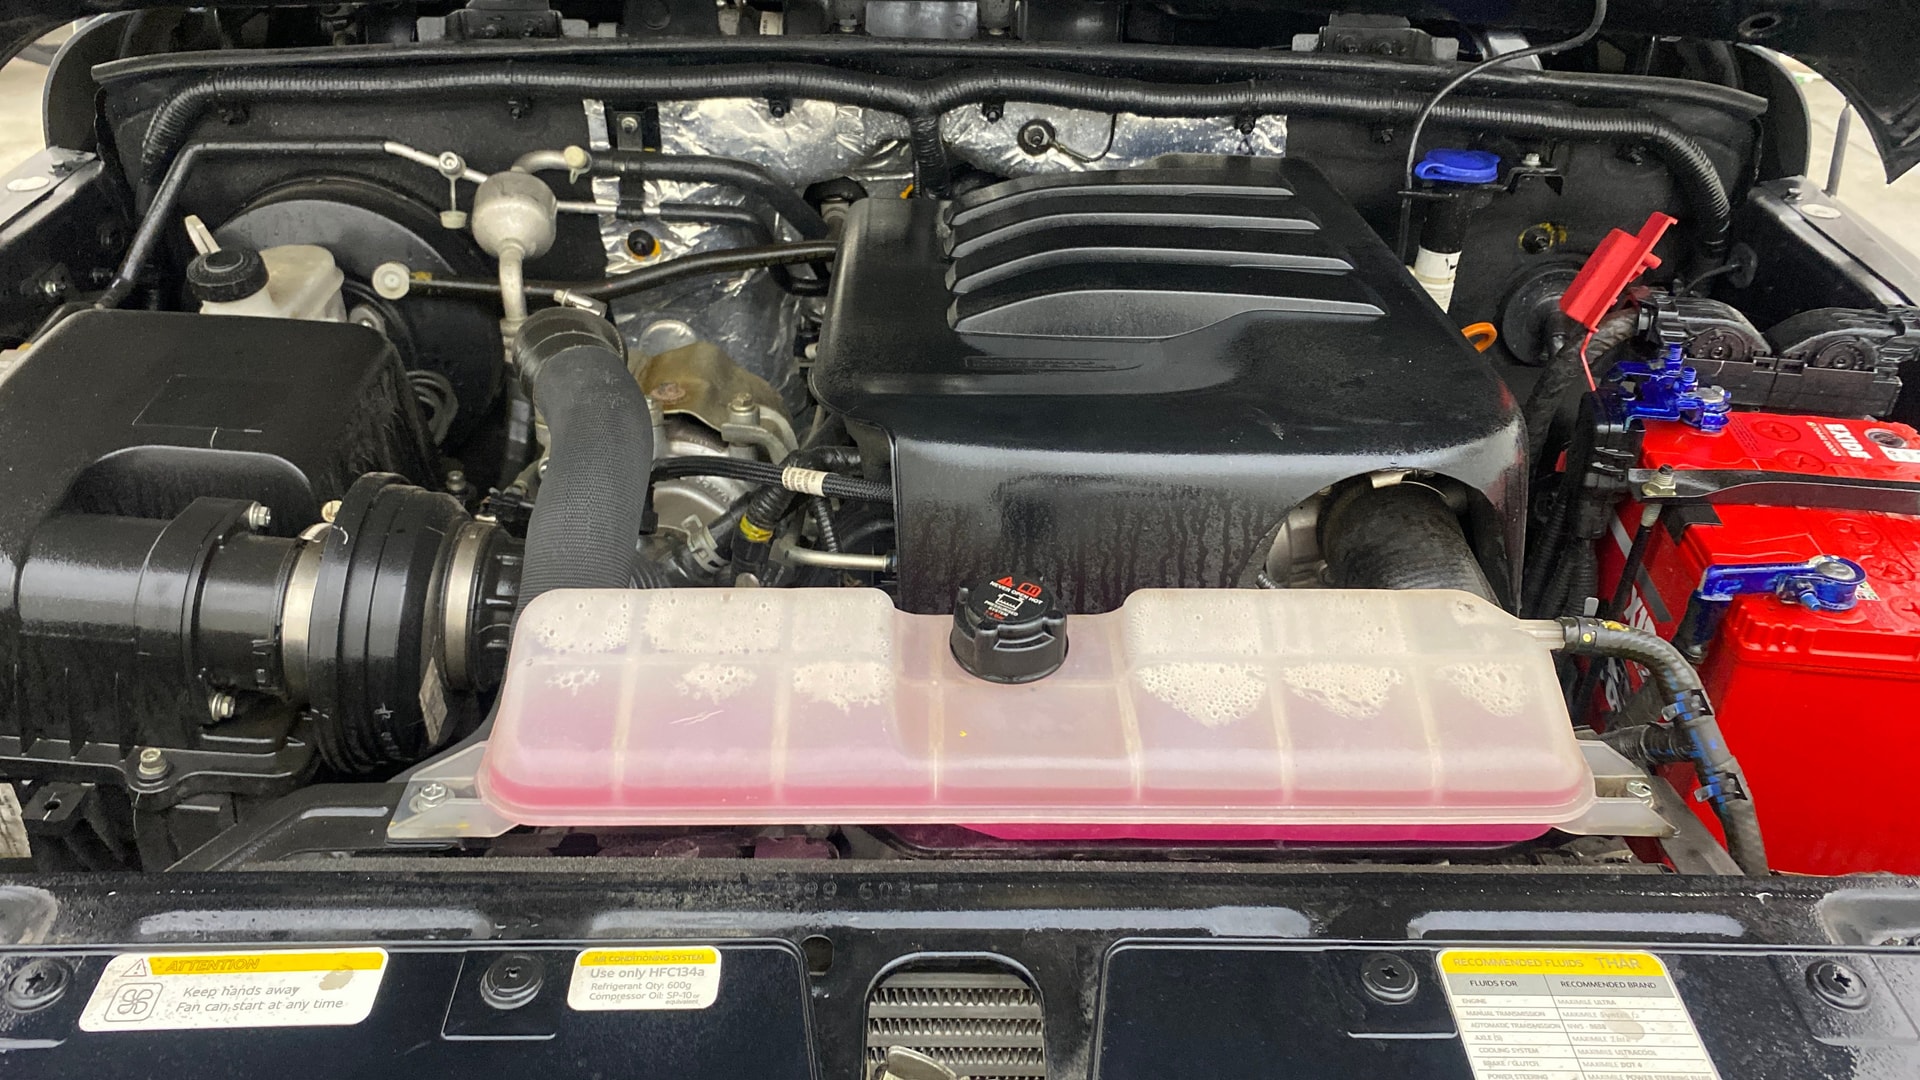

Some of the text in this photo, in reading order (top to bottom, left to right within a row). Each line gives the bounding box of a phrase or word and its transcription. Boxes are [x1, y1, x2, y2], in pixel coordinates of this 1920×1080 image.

[1824, 423, 1873, 460] EXIDE
[1011, 589, 1029, 600] OPEN
[165, 958, 260, 972] ATTENTION
[1453, 956, 1643, 970] RECOMMENDED FLUIDS THAR
[590, 966, 705, 980] Use only HFC134a
[591, 981, 692, 992] Refrigerant Qty: 600g
[1469, 979, 1518, 988] FLUIDS FOR
[1560, 980, 1657, 990] RECOMMENDED BRAND
[183, 986, 301, 998] Keep hands away
[589, 993, 646, 1003] Compressor
[666, 991, 692, 1000] SP-10
[175, 999, 344, 1013] Fan can start at any time
[1511, 1022, 1562, 1030] TRANSMISSION
